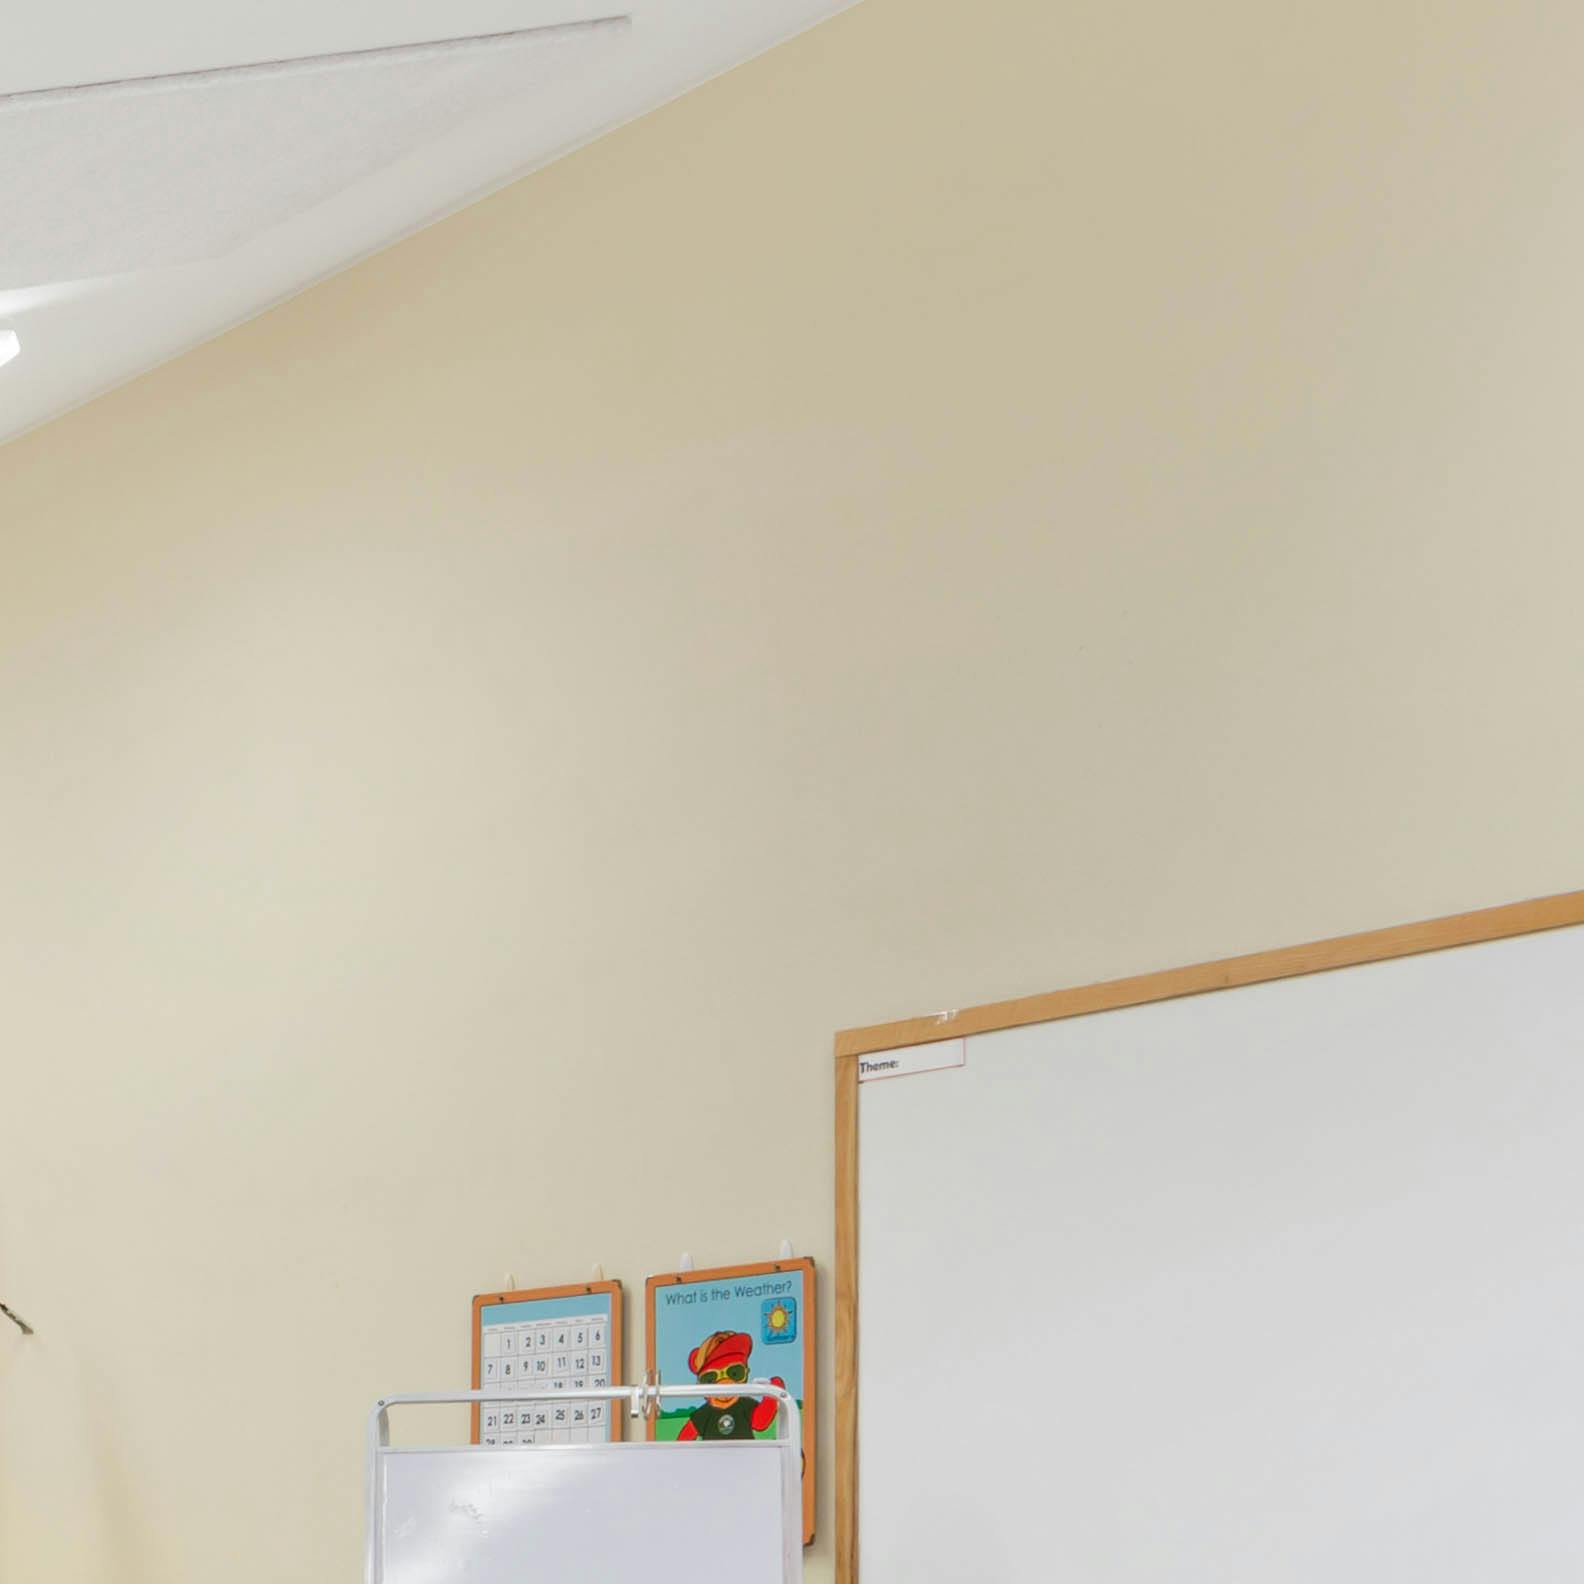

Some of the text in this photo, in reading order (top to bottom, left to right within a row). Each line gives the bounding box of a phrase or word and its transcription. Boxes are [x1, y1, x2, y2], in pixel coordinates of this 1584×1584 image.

[859, 1060, 899, 1074] Theme:
[665, 1280, 792, 1305] What is the Weather?
[558, 1334, 564, 1344] 4
[577, 1332, 583, 1343] 5
[595, 1330, 601, 1341] 6
[505, 1365, 511, 1375] 8
[536, 1361, 545, 1372] 10
[557, 1357, 566, 1368] 11
[575, 1359, 584, 1369] 12
[592, 1355, 601, 1366] 13
[487, 1407, 601, 1427] 21 22 23 24 25 26 27
